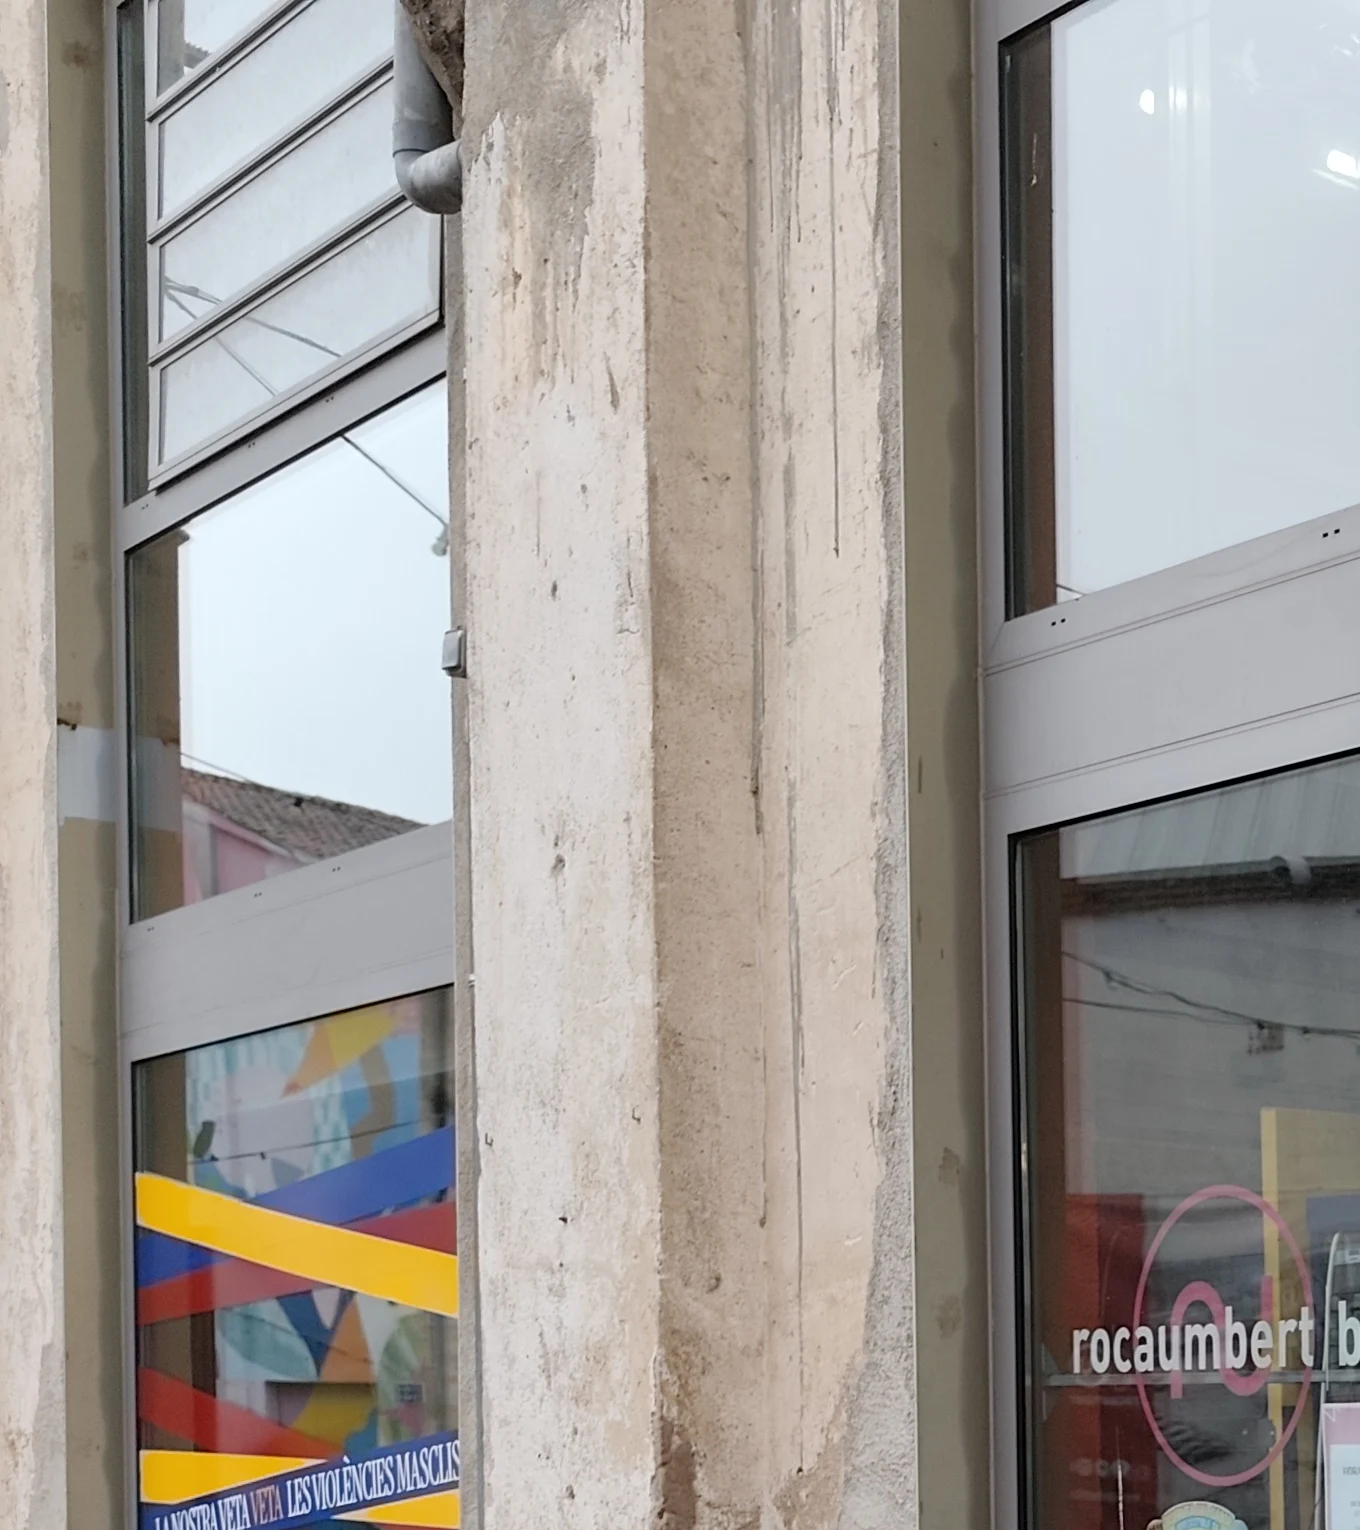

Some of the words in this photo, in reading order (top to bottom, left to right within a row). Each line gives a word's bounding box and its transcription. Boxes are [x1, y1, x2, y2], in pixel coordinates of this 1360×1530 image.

[1072, 1305, 1315, 1374] rocaumbert
[250, 1484, 284, 1526] VETA
[286, 1477, 312, 1518] LES
[311, 1454, 395, 1511] VIOLÈNCIES
